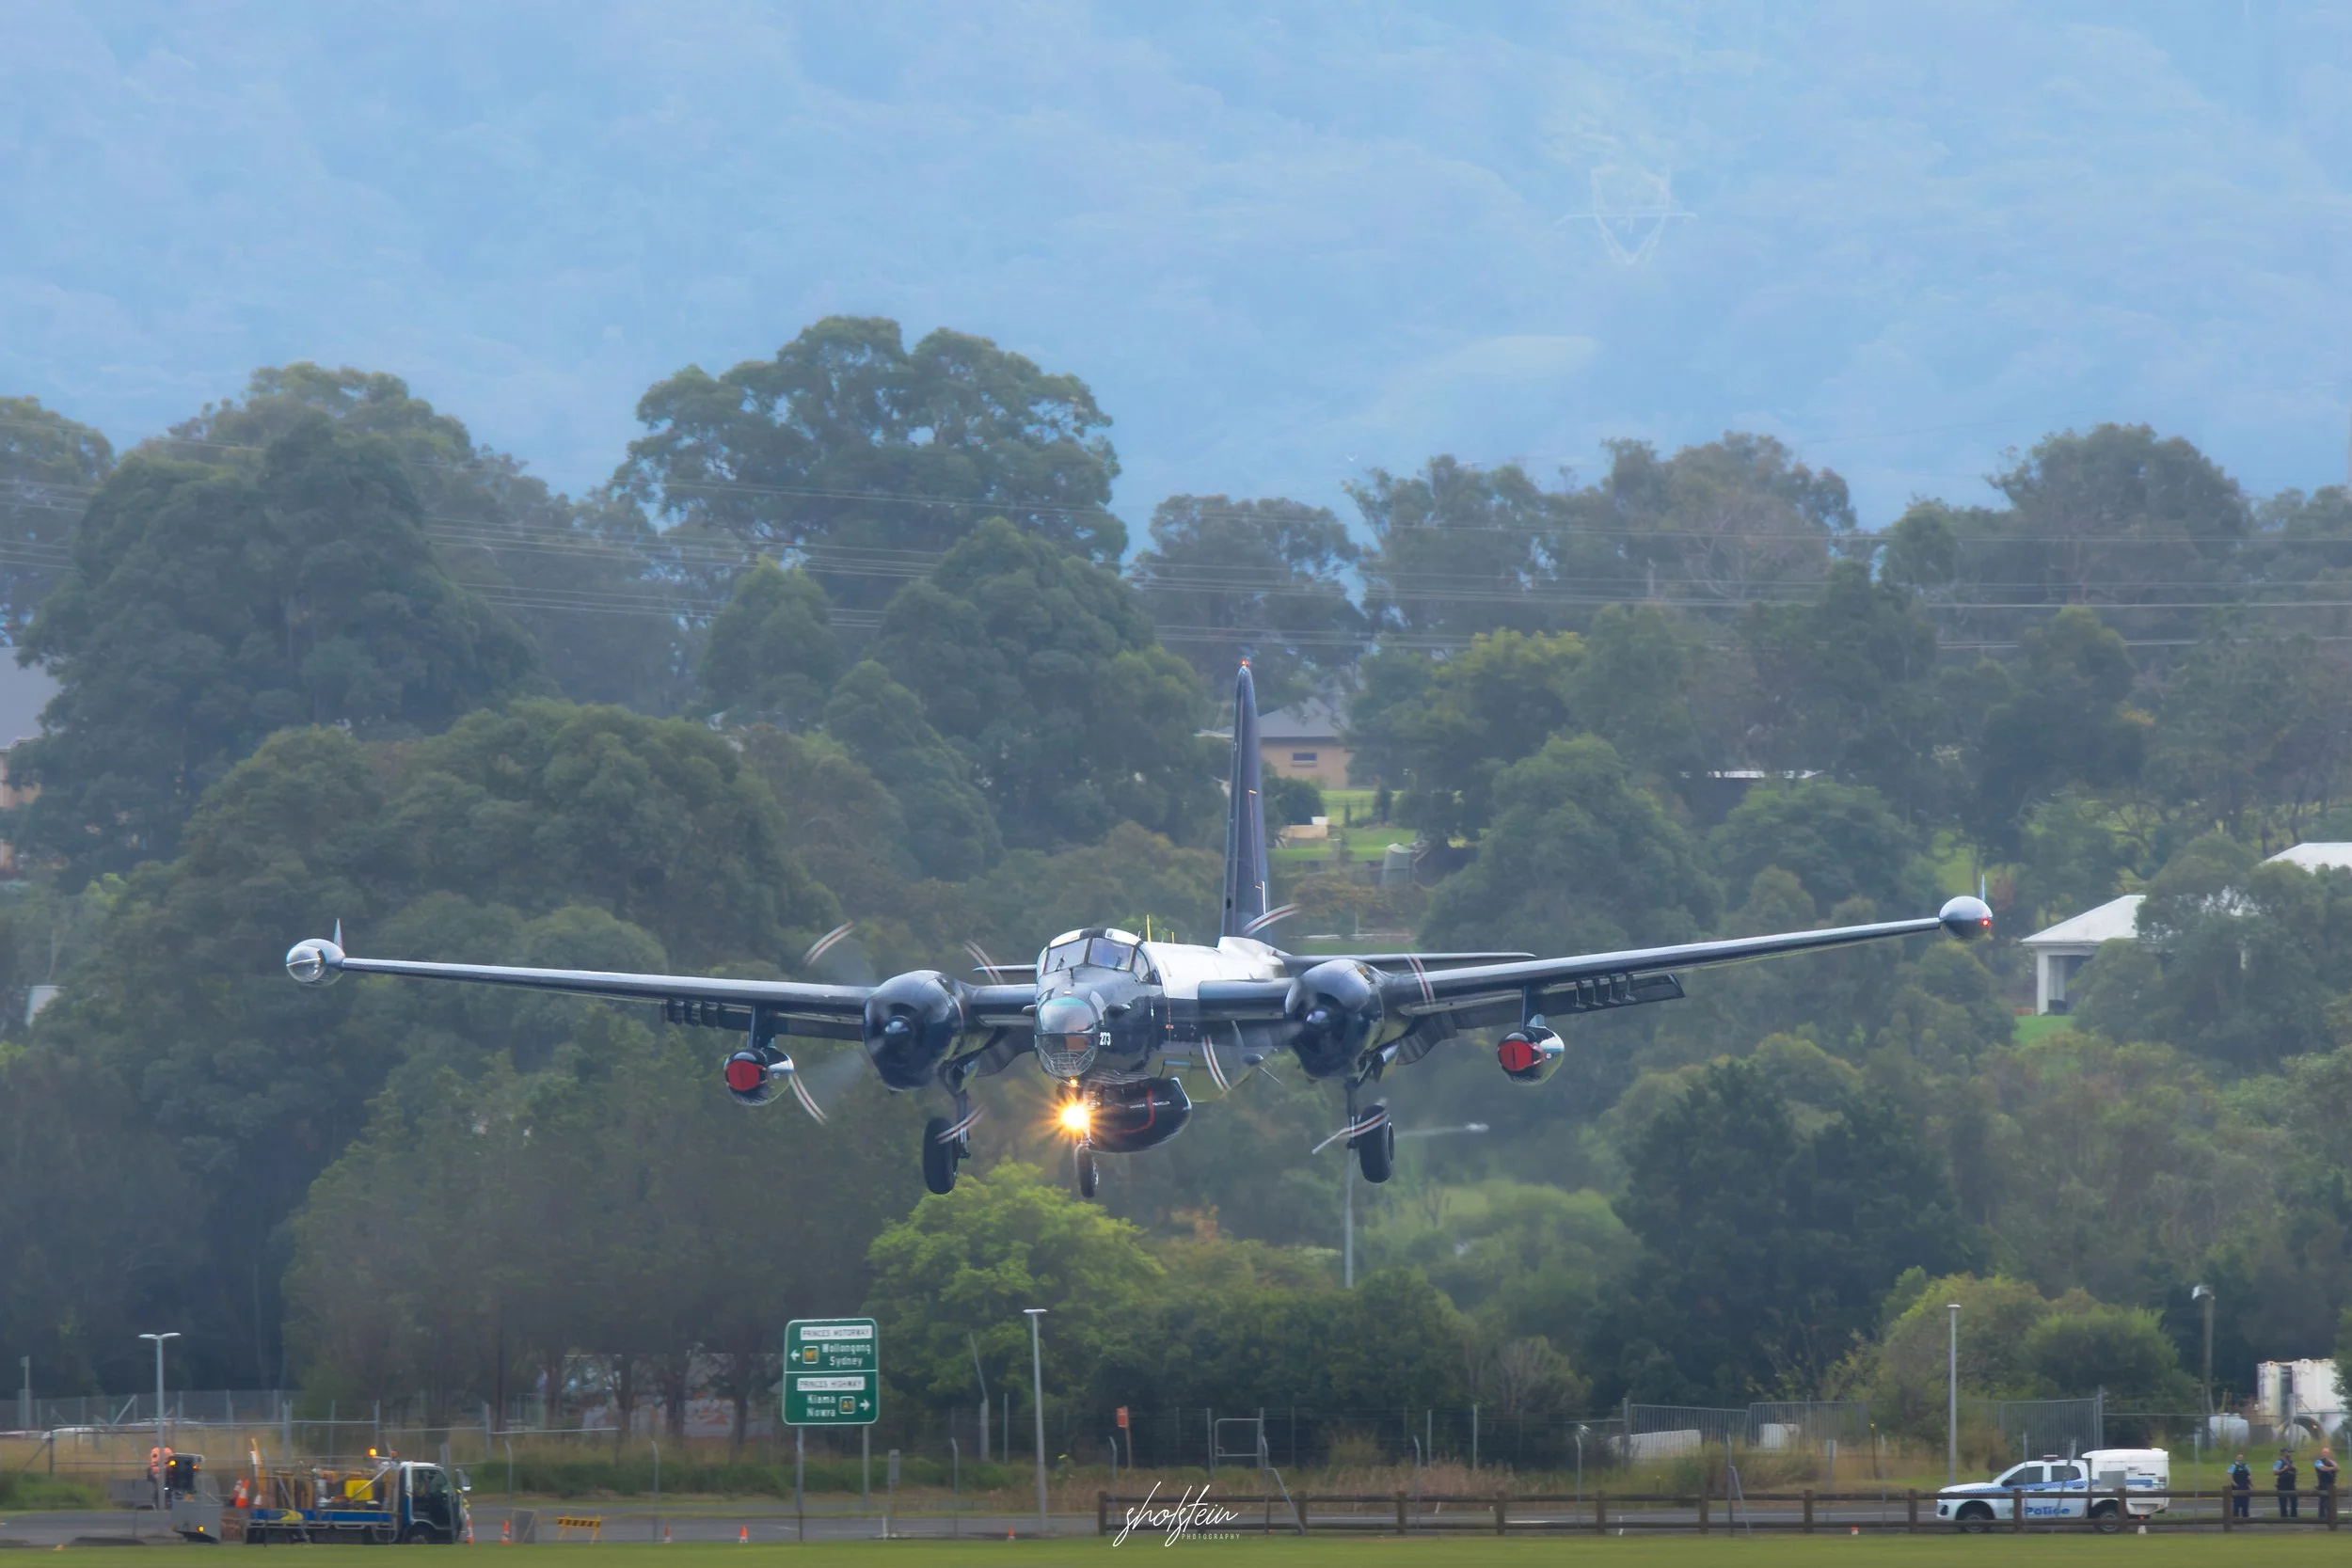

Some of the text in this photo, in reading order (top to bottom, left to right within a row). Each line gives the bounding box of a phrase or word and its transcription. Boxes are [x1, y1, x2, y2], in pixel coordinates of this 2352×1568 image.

[1099, 1032, 1111, 1046] 273
[821, 1343, 871, 1354] Wollongong
[829, 1356, 863, 1368] Sydney
[806, 1394, 835, 1404] Kiama
[806, 1407, 835, 1418] Nowra
[2025, 1506, 2071, 1515] Police
